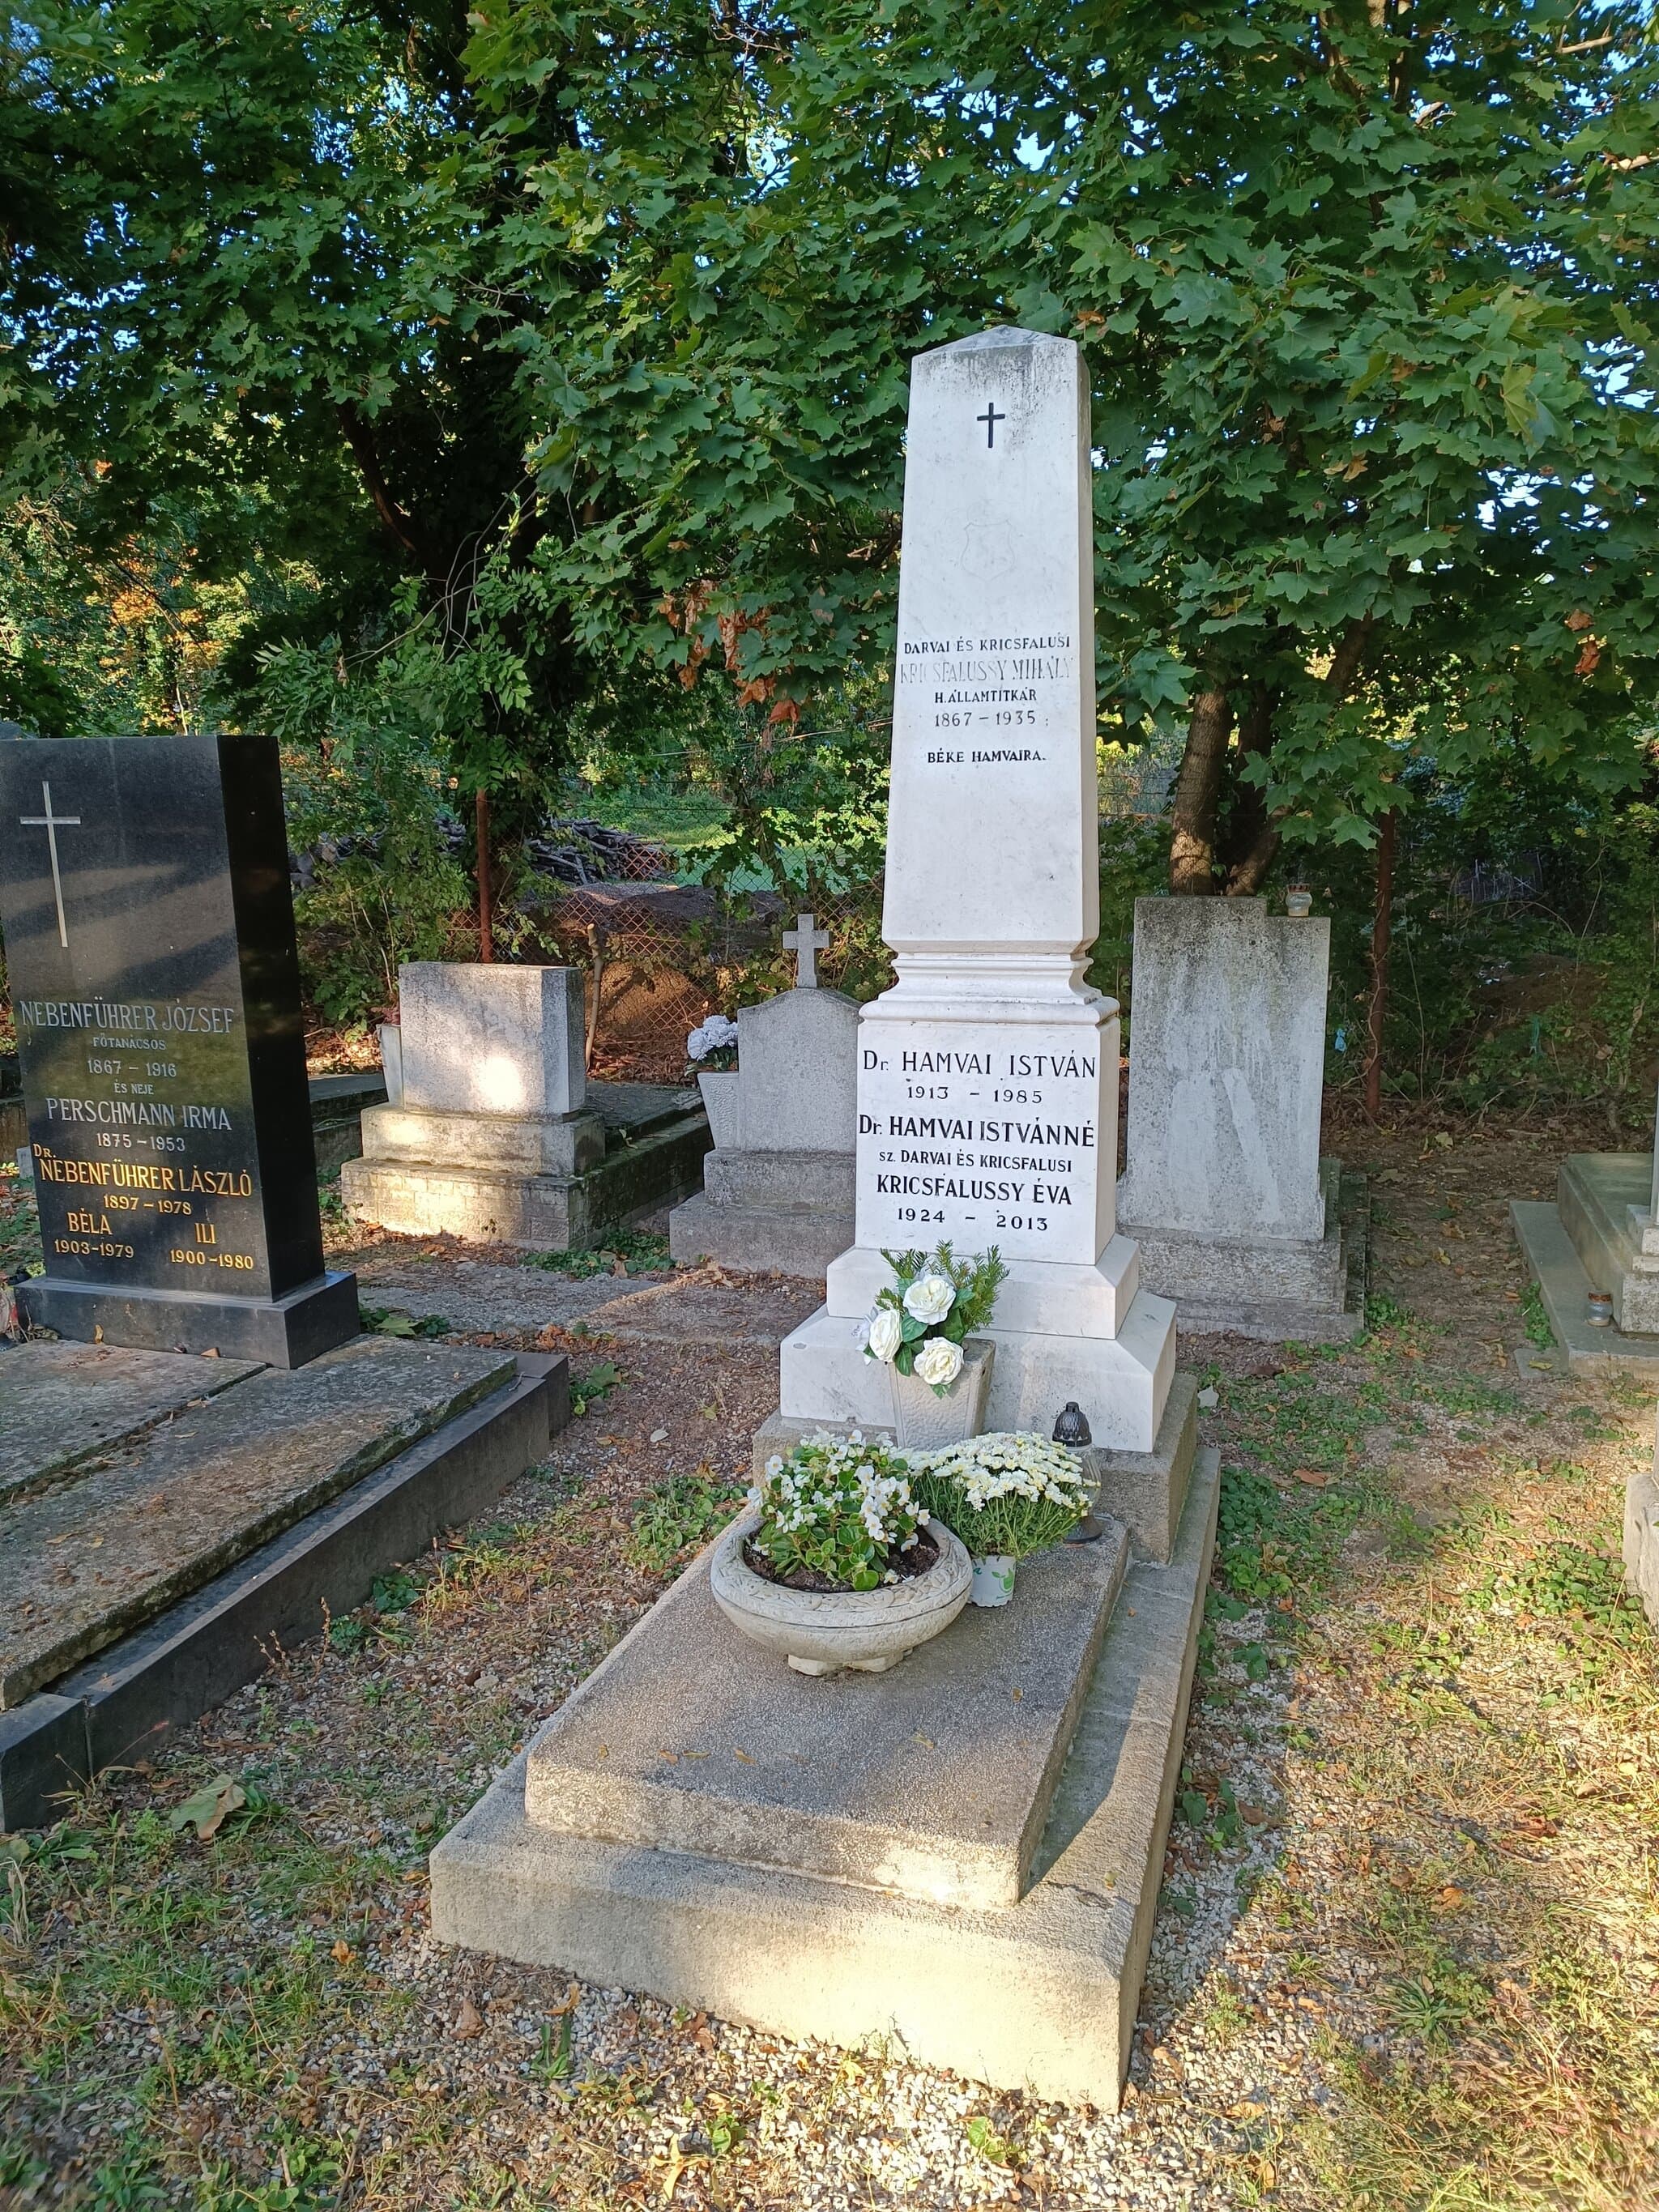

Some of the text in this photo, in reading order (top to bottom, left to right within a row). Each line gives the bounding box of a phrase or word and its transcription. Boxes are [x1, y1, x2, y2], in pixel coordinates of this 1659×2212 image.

[904, 636, 1070, 654] DARVAI ÉS KRICSFALUSI
[935, 712, 972, 727] 1867
[996, 710, 1036, 725] 1935
[928, 747, 965, 763] BÉKE
[19, 996, 234, 1034] NEBENFÜHRER JÓZSEF
[87, 1059, 122, 1074] 1867
[146, 1062, 177, 1077] 1916
[863, 1050, 1096, 1078] Dr. HAMVAI ISTVÁN
[114, 1079, 154, 1094] ÉS NEJE
[907, 1086, 949, 1100] 1913
[994, 1089, 1043, 1104] 1985
[45, 1097, 232, 1130] PERSCHMANN IRMA
[859, 1115, 1094, 1147] Dr. HAMVAI ISTVÁNNÉ
[96, 1133, 131, 1149] 1875
[151, 1136, 186, 1152] 1953
[901, 1150, 951, 1166] DARVAI
[957, 1149, 975, 1166] ÉS
[980, 1155, 1072, 1173] KRICSFALUSI
[40, 1159, 252, 1196] NEBENFÜHRER LÁSZLÓ
[876, 1174, 1072, 1205] KRICSFALUSSY ÉVA
[104, 1194, 138, 1209] 1897
[158, 1200, 192, 1215] 1978
[67, 1208, 113, 1235] BÉLA
[898, 1208, 945, 1223] 1924
[996, 1215, 1048, 1231] 2013
[194, 1223, 217, 1244] ILI
